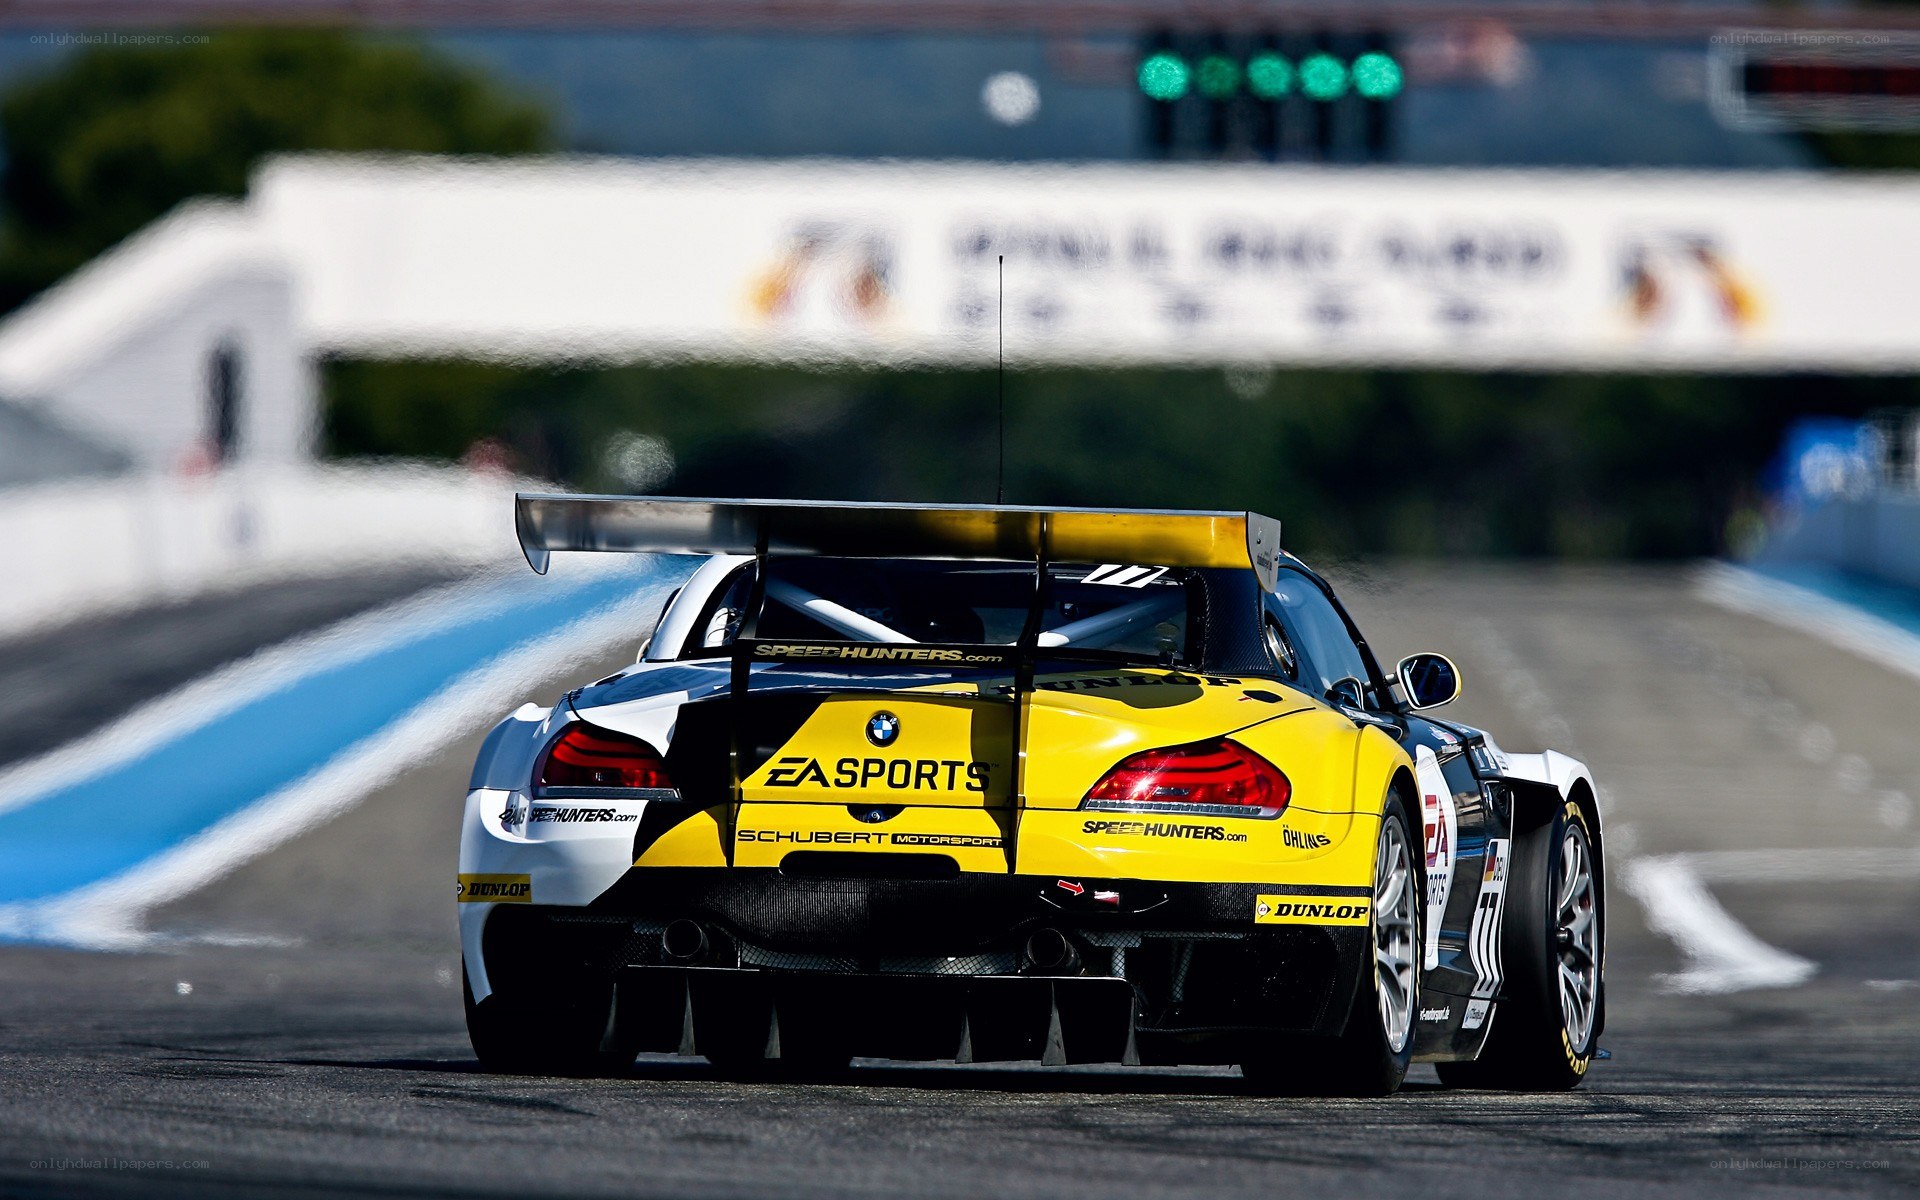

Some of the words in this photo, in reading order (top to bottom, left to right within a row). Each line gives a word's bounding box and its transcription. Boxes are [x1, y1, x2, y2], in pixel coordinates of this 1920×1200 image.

[754, 644, 1003, 663] SPEEDHUNTERS.com
[834, 757, 991, 792] SPORTS
[737, 830, 889, 844] SCHUBERT
[895, 834, 1003, 847] MOTORSPORT
[1082, 820, 1247, 842] SPEEDHUNTERS.com
[1282, 824, 1331, 849] ÖHLINS
[467, 882, 530, 897] DUNLOP
[1426, 874, 1447, 906] ORTS
[1274, 903, 1369, 919] DUNLOP
